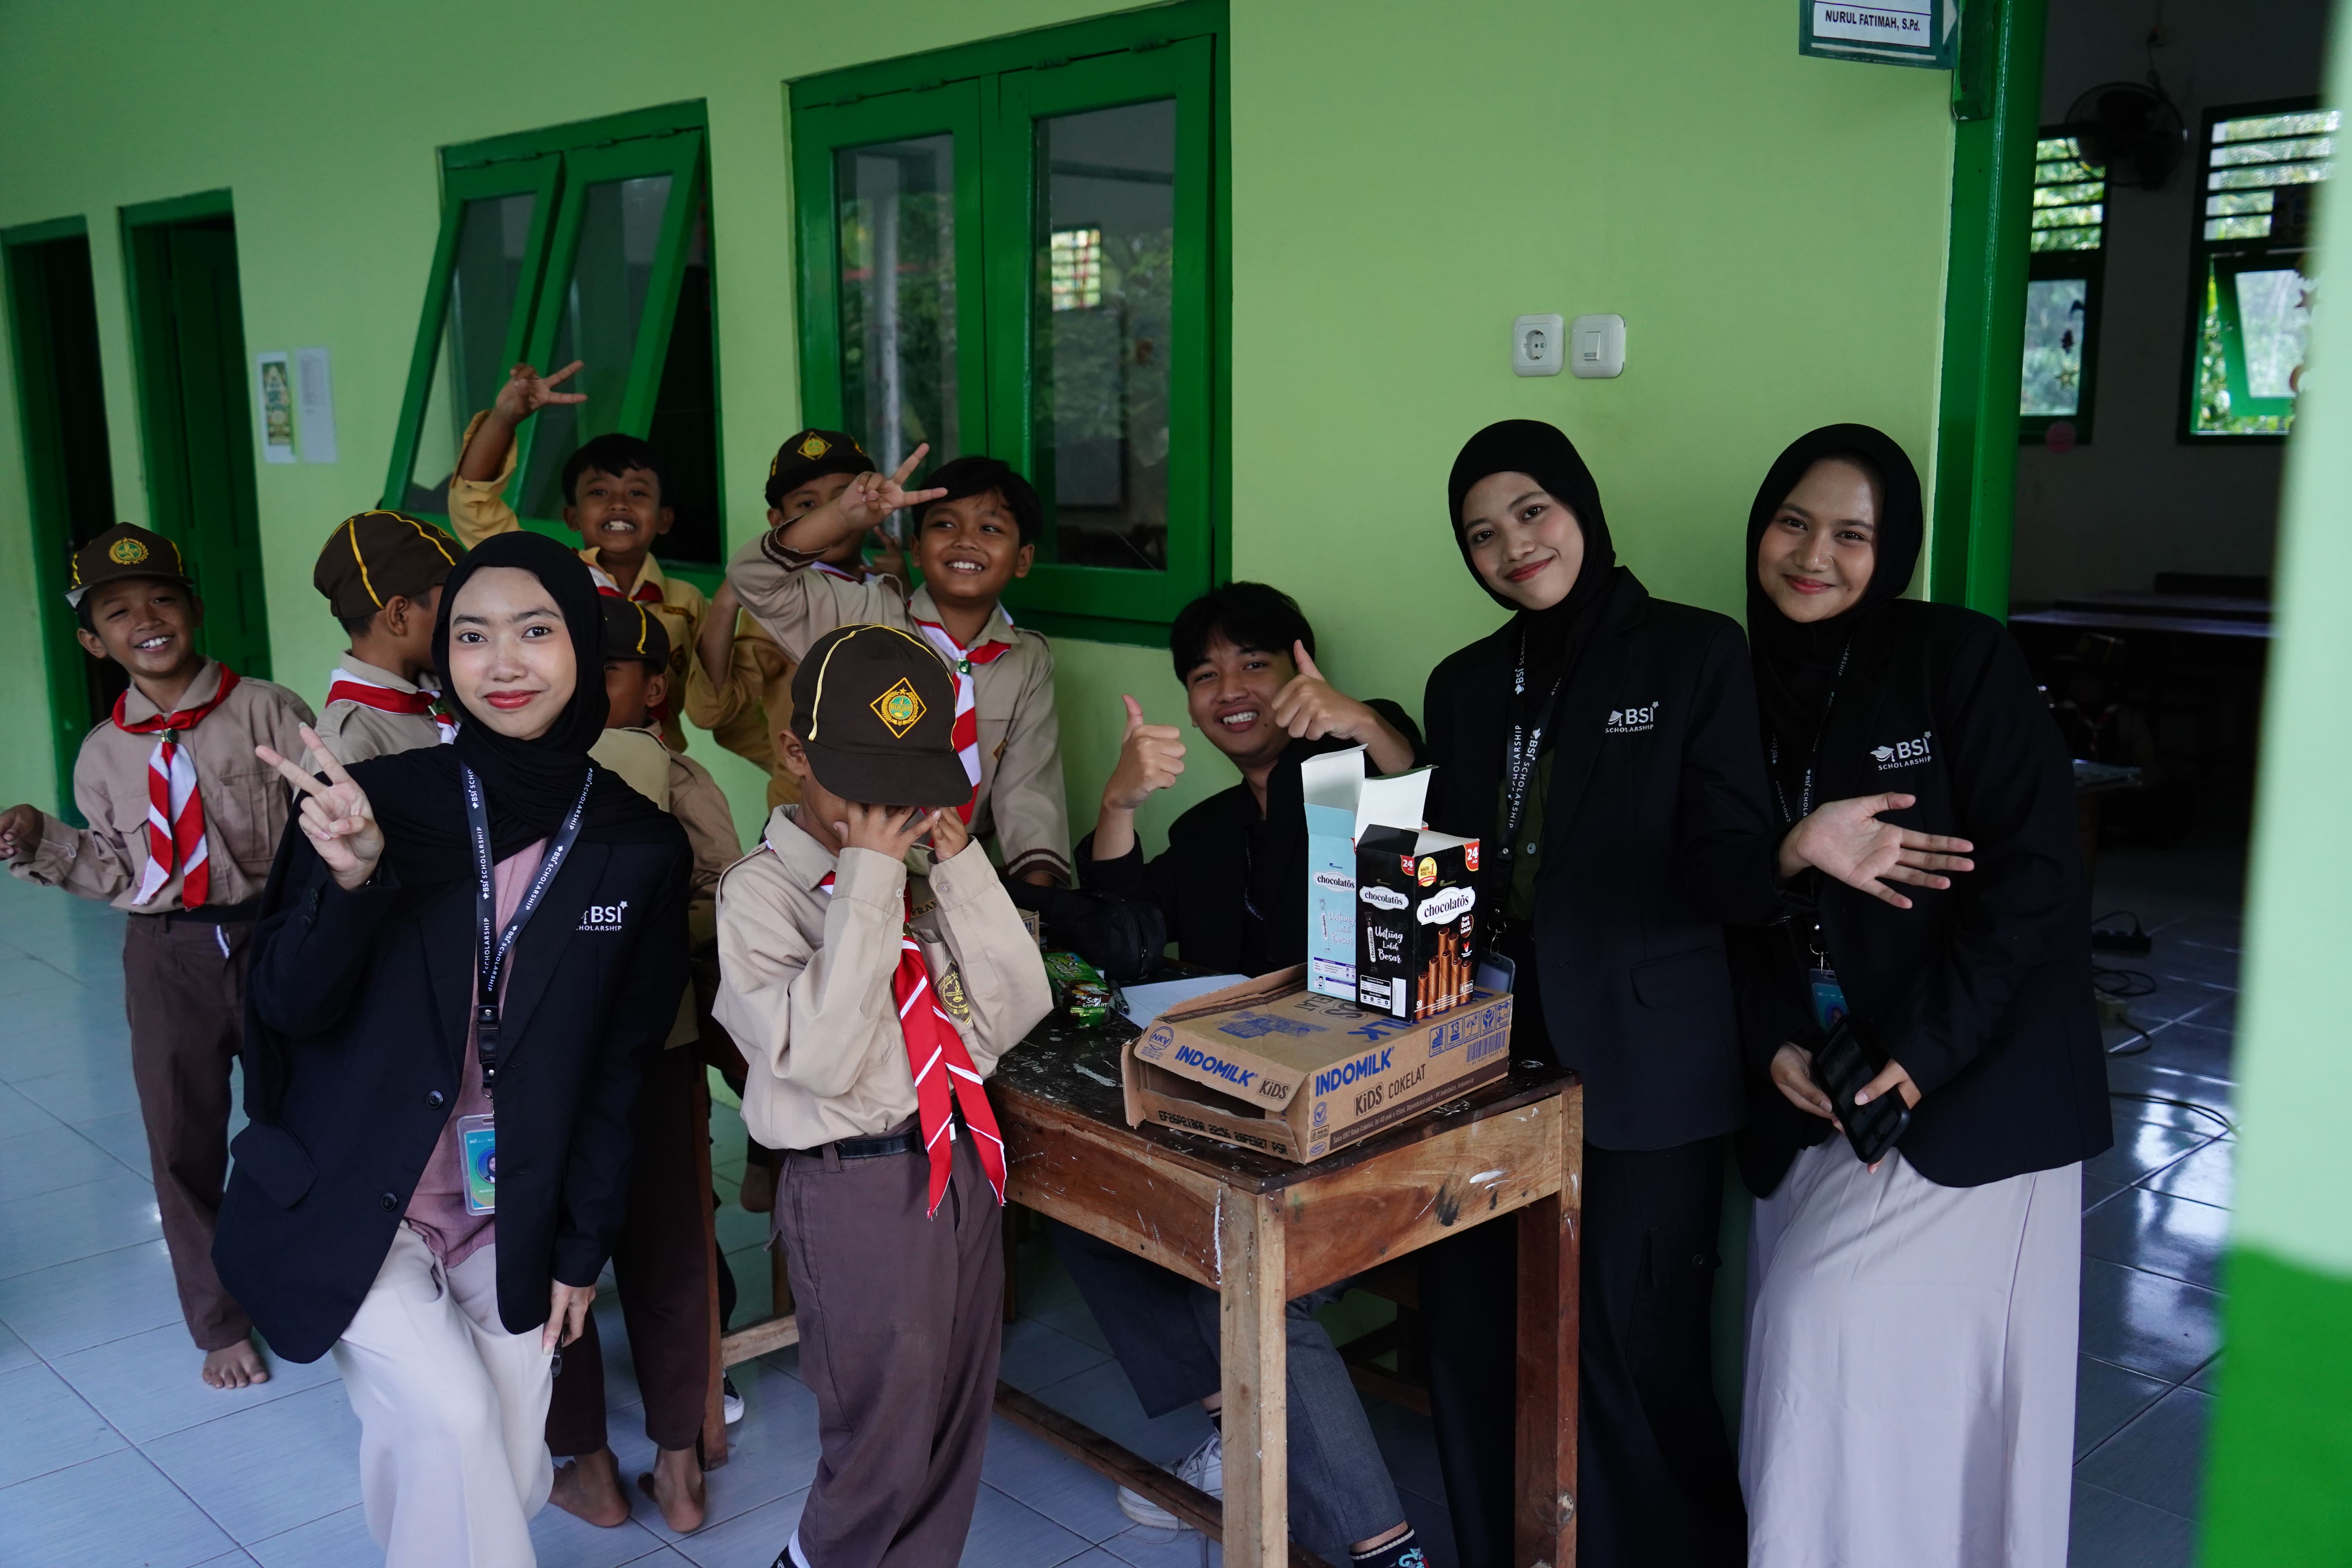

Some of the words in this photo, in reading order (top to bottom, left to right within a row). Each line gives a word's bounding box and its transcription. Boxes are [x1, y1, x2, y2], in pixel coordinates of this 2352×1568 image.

[1826, 10, 1857, 24] NURUL
[1860, 14, 1899, 31] FATIMAH,
[1902, 18, 1920, 31] S.Pd.
[1515, 668, 1524, 684] BSI
[1626, 707, 1653, 724] BSI
[1605, 724, 1654, 733] SCHOLARSHIP
[1526, 740, 1538, 758] BSI
[1896, 738, 1929, 759] BSI
[1878, 755, 1932, 771] SCHOLARSHIP
[1509, 761, 1530, 828] SCHOLARSHIP
[569, 783, 590, 830] SCHOLARSHIP
[477, 826, 488, 878] SCHOLARSHIP
[551, 851, 561, 862] BSI
[1467, 847, 1479, 861] 24
[1403, 859, 1414, 868] 24
[1430, 863, 1434, 875] 1
[526, 863, 554, 910] SCHOLARSHIP
[591, 906, 622, 923] BSI
[1461, 920, 1470, 928] Dark
[505, 931, 514, 942] BSI
[1375, 926, 1404, 944] Untung
[1383, 940, 1399, 951] Lebih
[1377, 948, 1402, 964] Besar
[488, 942, 507, 992] SCHOLARSHIP
[1451, 1022, 1459, 1034] 13
[1152, 1033, 1171, 1045] NKV
[1388, 1063, 1426, 1099] COKELAT
[1333, 1135, 1342, 1144] Susu
[1343, 1131, 1351, 1140] UHT
[1351, 1128, 1359, 1136] Rasa
[1406, 1098, 1426, 1112] Diproduksi
[1457, 1078, 1474, 1089] Indonesia
